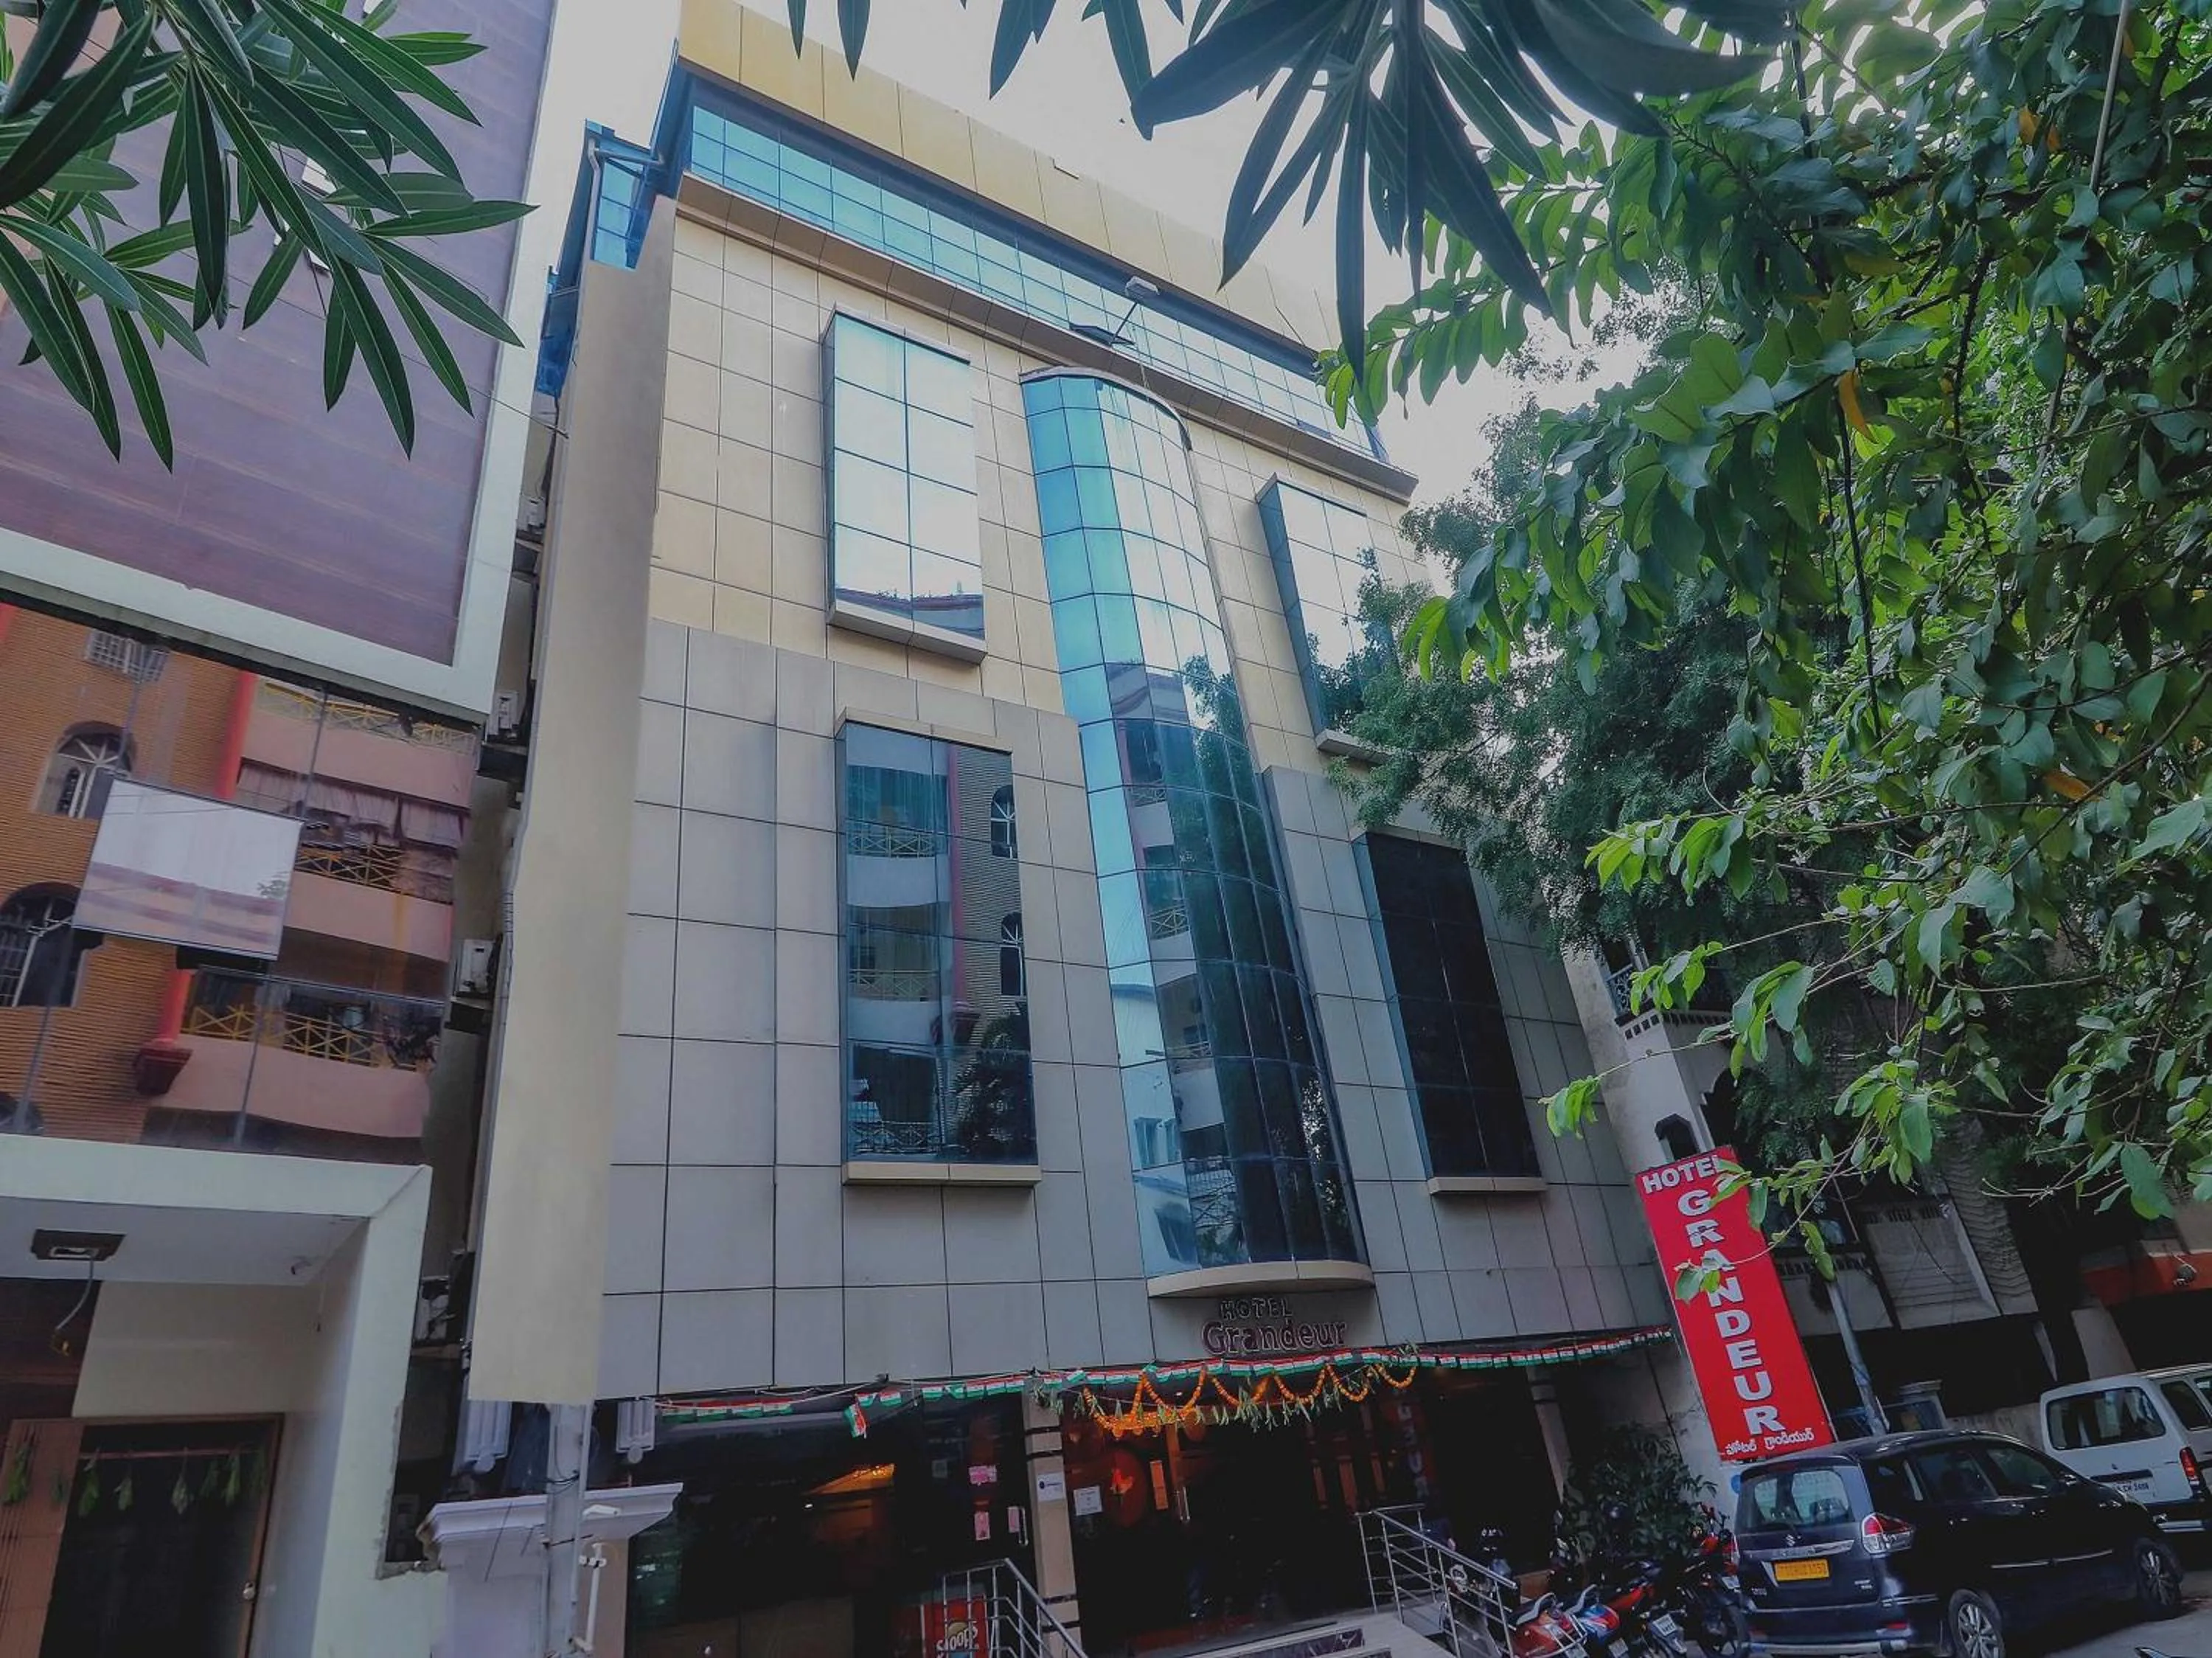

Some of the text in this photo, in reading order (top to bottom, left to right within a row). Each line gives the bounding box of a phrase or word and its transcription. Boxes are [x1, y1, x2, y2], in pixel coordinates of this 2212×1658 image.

[1220, 1297, 1293, 1322] HOTEL
[1677, 1189, 1786, 1435] GRANDEUR
[1202, 1317, 1348, 1356] Grandeur
